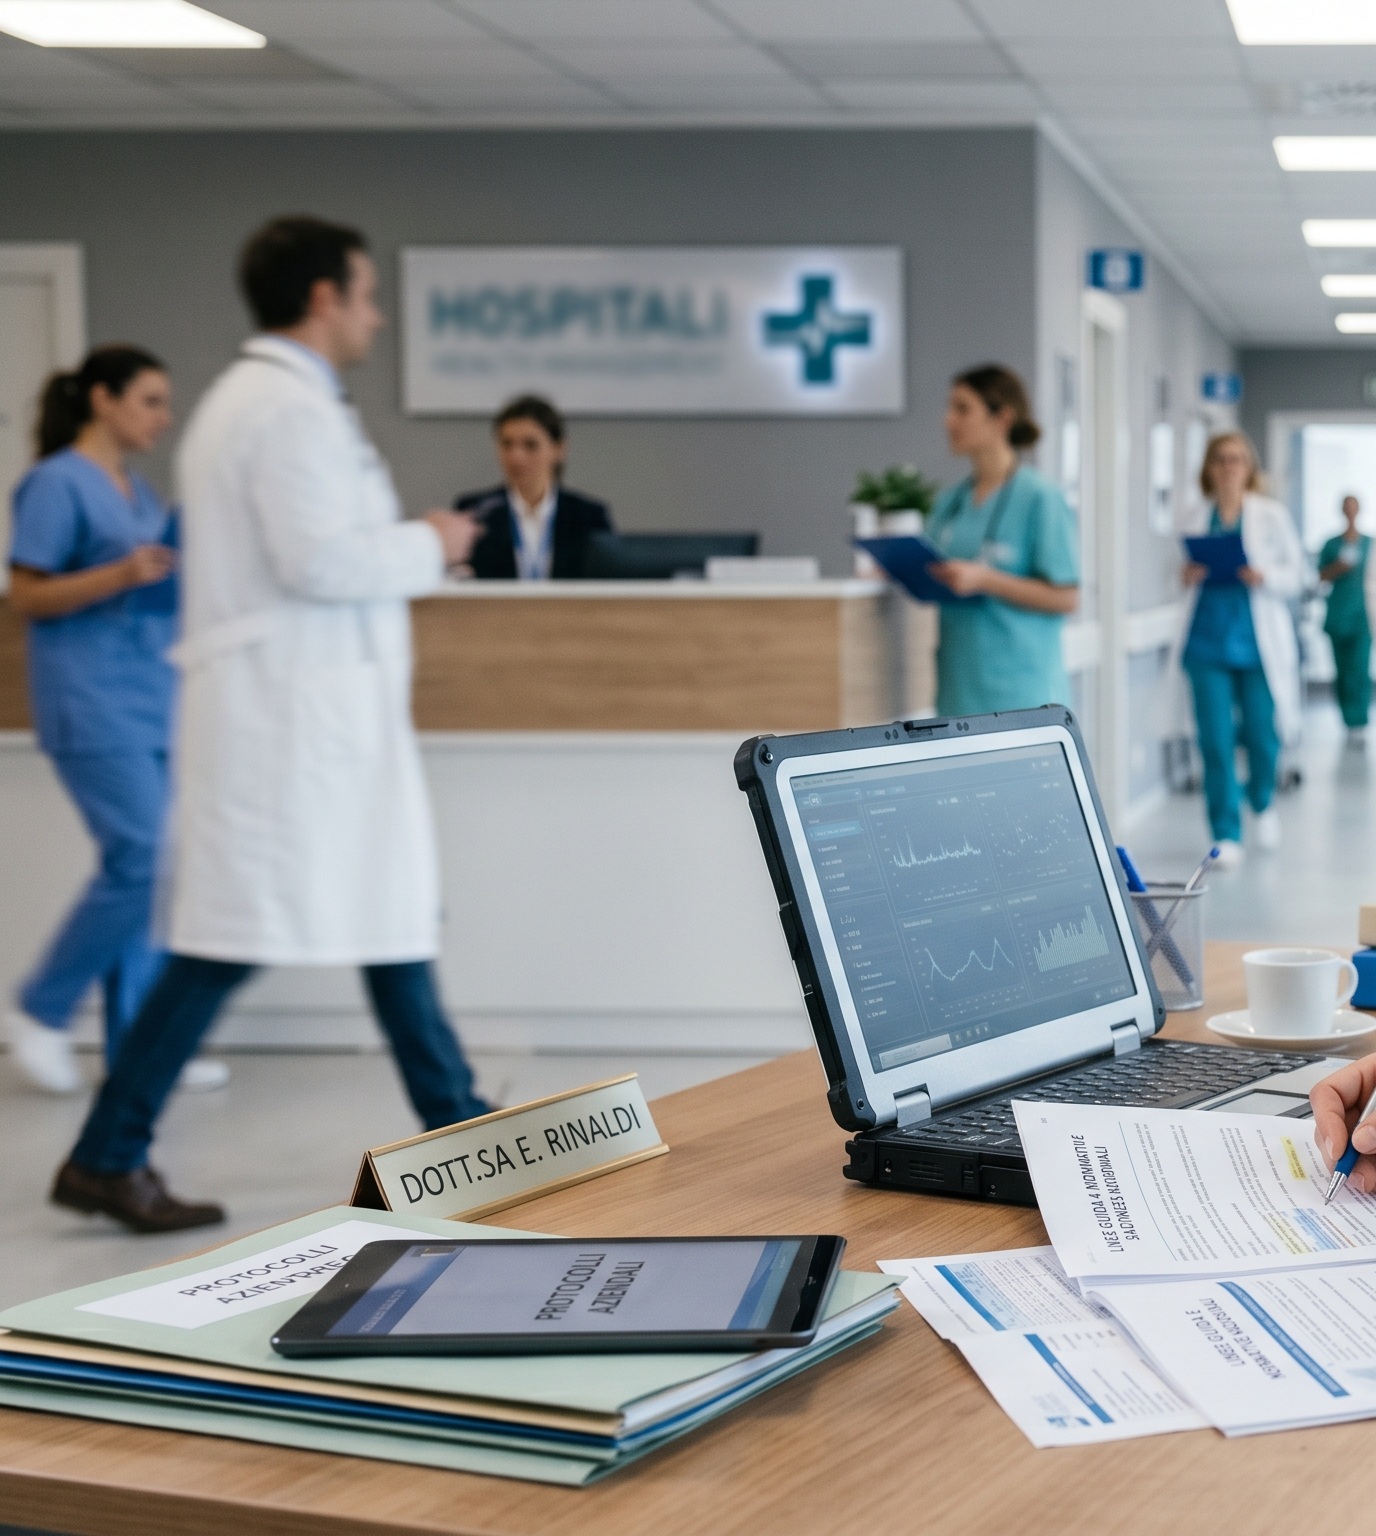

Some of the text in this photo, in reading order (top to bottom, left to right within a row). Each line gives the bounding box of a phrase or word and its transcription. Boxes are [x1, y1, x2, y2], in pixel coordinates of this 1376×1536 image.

[399, 1102, 642, 1204] DOTT.SA E. RINALDI
[177, 1244, 339, 1297] PROTOCOLLI
[533, 1253, 607, 1321] PROTOCOLLI
[587, 1260, 646, 1315] AZIENDALI
